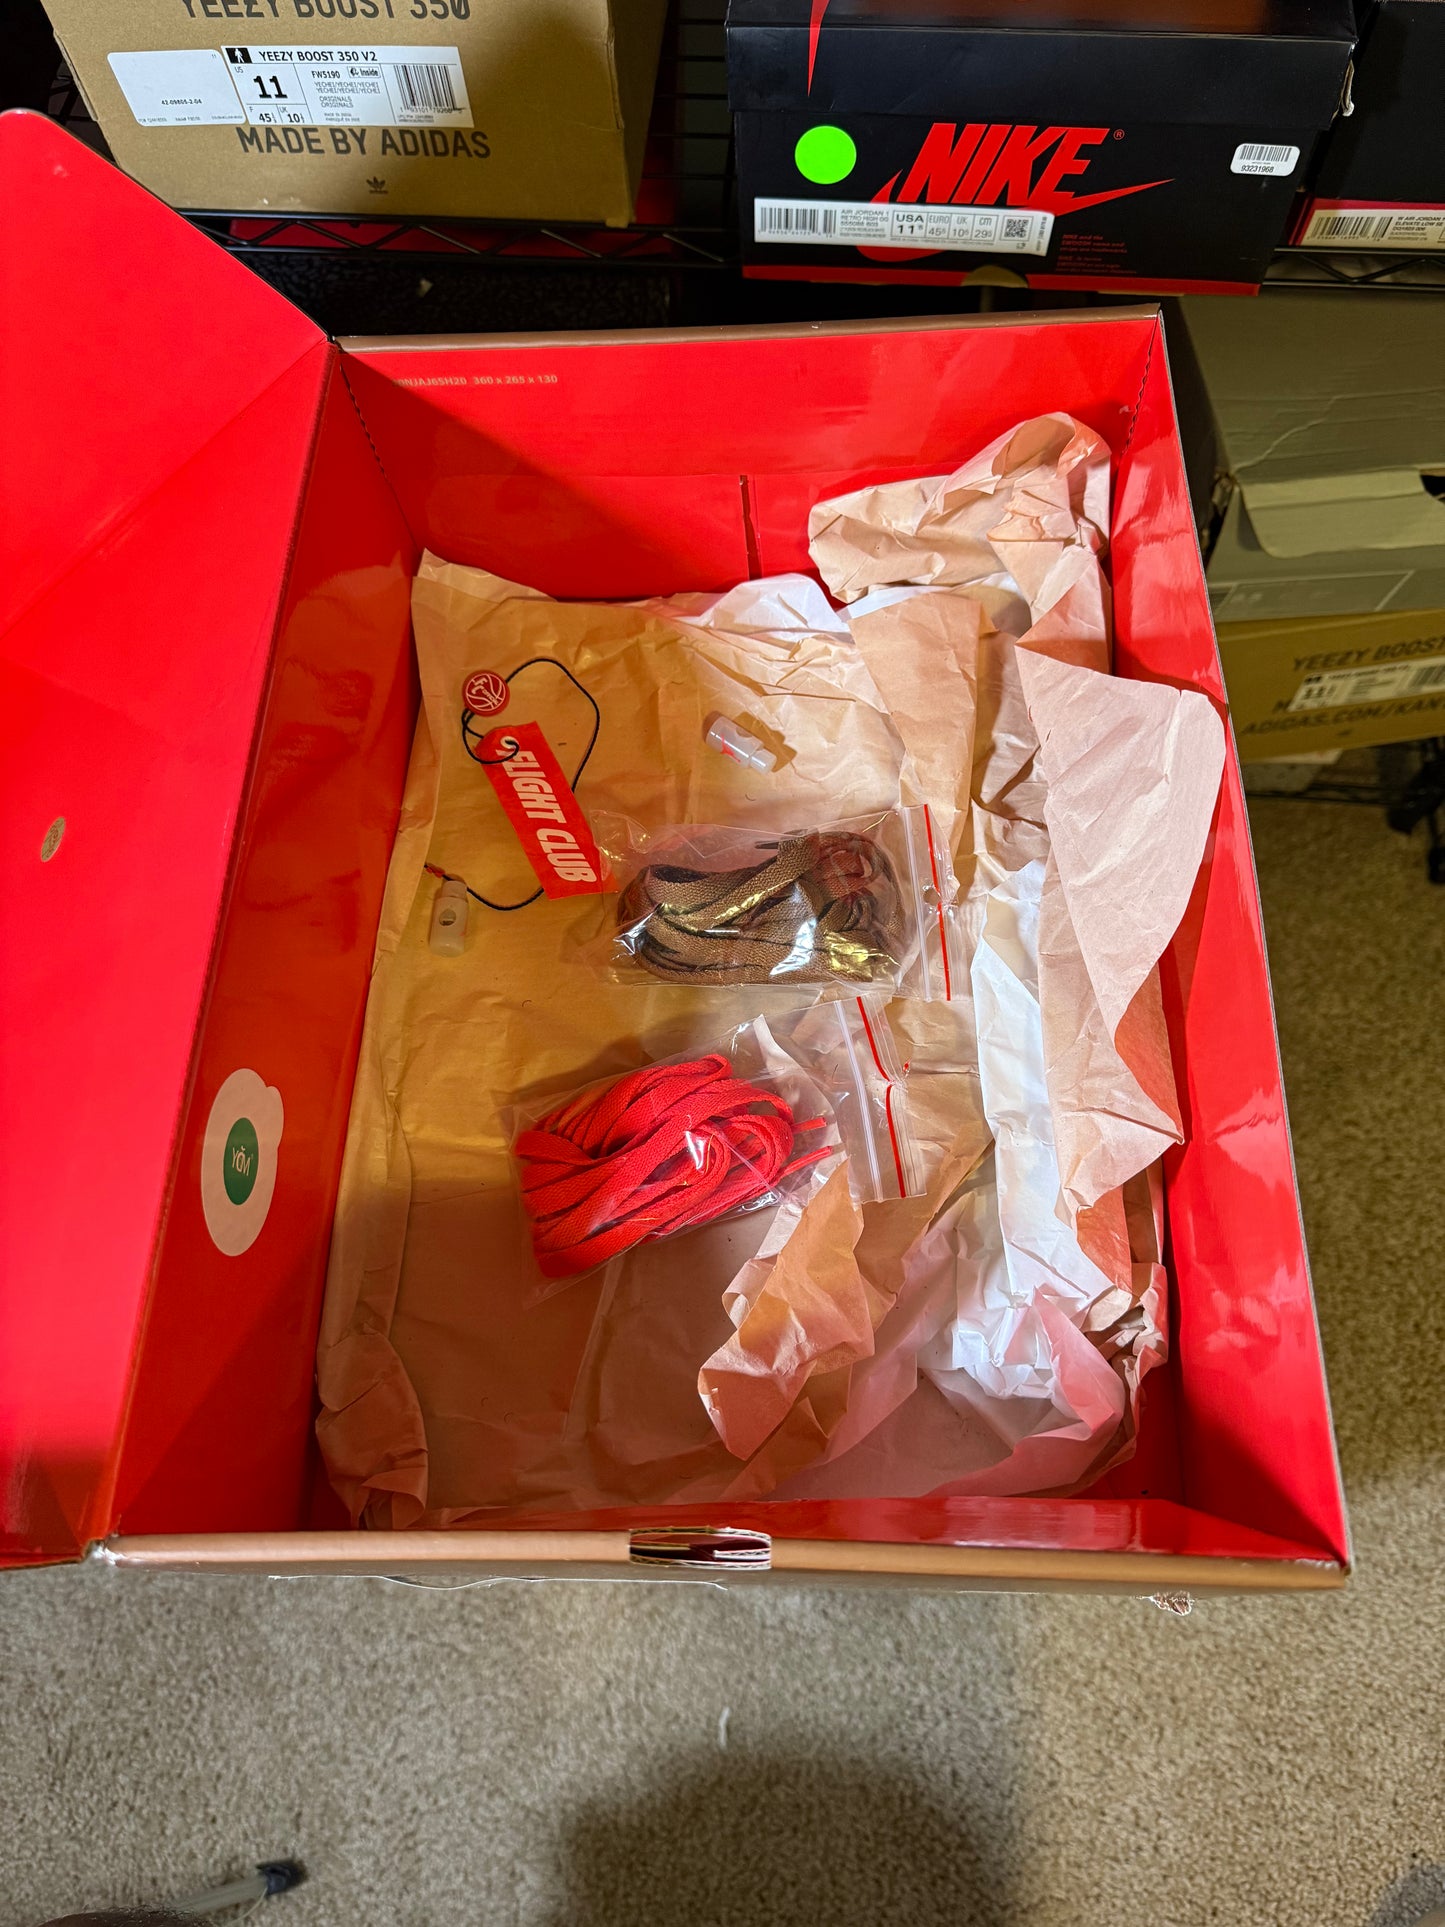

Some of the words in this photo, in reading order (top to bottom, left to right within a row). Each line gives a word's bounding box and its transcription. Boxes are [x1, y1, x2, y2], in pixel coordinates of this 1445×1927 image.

[182, 0, 283, 18] YEEZY
[296, 0, 396, 19] BOOST
[410, 0, 471, 20] 350
[258, 51, 294, 62] YEEZY
[297, 51, 335, 62] BOOST
[338, 51, 360, 62] 350
[361, 51, 378, 62] V2
[234, 66, 244, 74] US
[311, 70, 341, 80] FW5190
[359, 68, 379, 77] Inside
[253, 75, 288, 99] 11
[320, 101, 354, 109] ORIGINALS
[236, 126, 325, 155] MADE
[329, 128, 367, 155] BY
[382, 129, 491, 159] ADIDAS
[896, 122, 1110, 206] NIKE
[896, 213, 925, 223] USA
[928, 215, 950, 225] EURO
[956, 216, 968, 225] UK
[472, 375, 494, 385] 360
[505, 375, 525, 385] 265
[538, 374, 558, 384] 130
[1293, 648, 1370, 671] YEEZY
[495, 749, 567, 824] FLIGHT
[536, 827, 598, 883] CLUB
